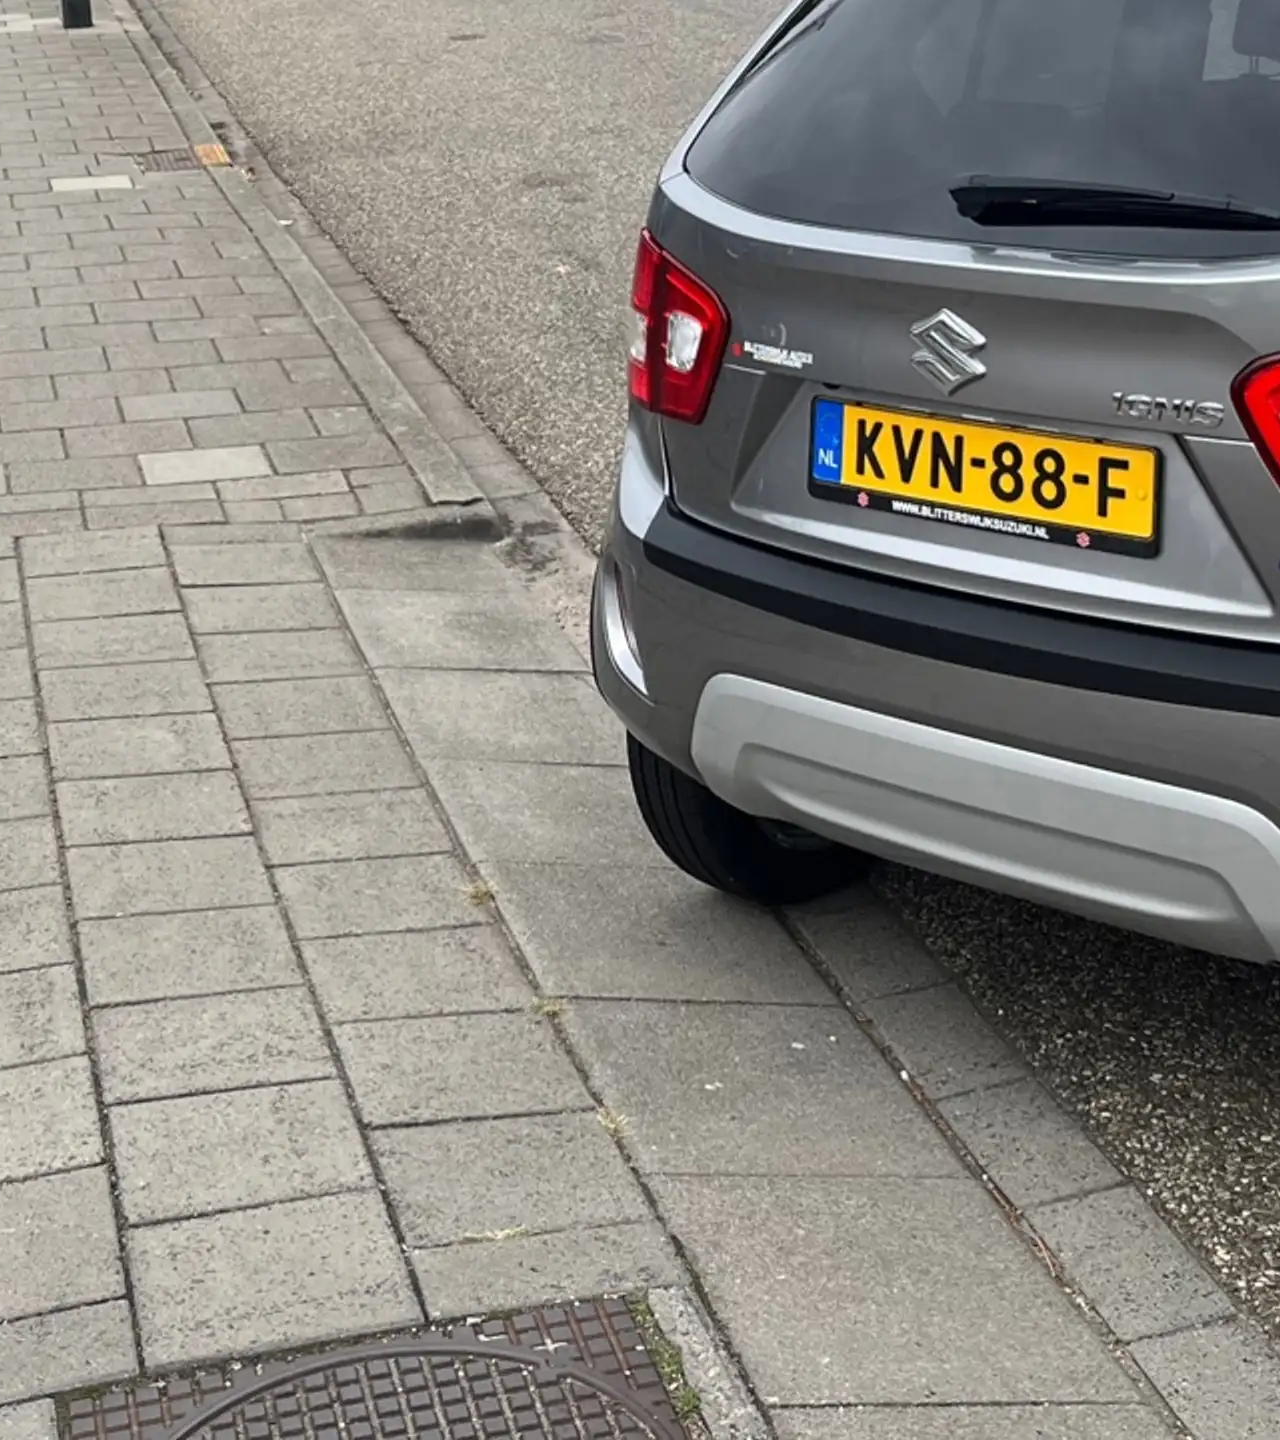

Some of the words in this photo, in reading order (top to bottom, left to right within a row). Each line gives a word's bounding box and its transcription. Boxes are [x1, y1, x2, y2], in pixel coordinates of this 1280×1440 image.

[1111, 392, 1225, 428] IGNIS
[818, 447, 838, 469] NL
[856, 418, 1130, 519] KVN-88-F
